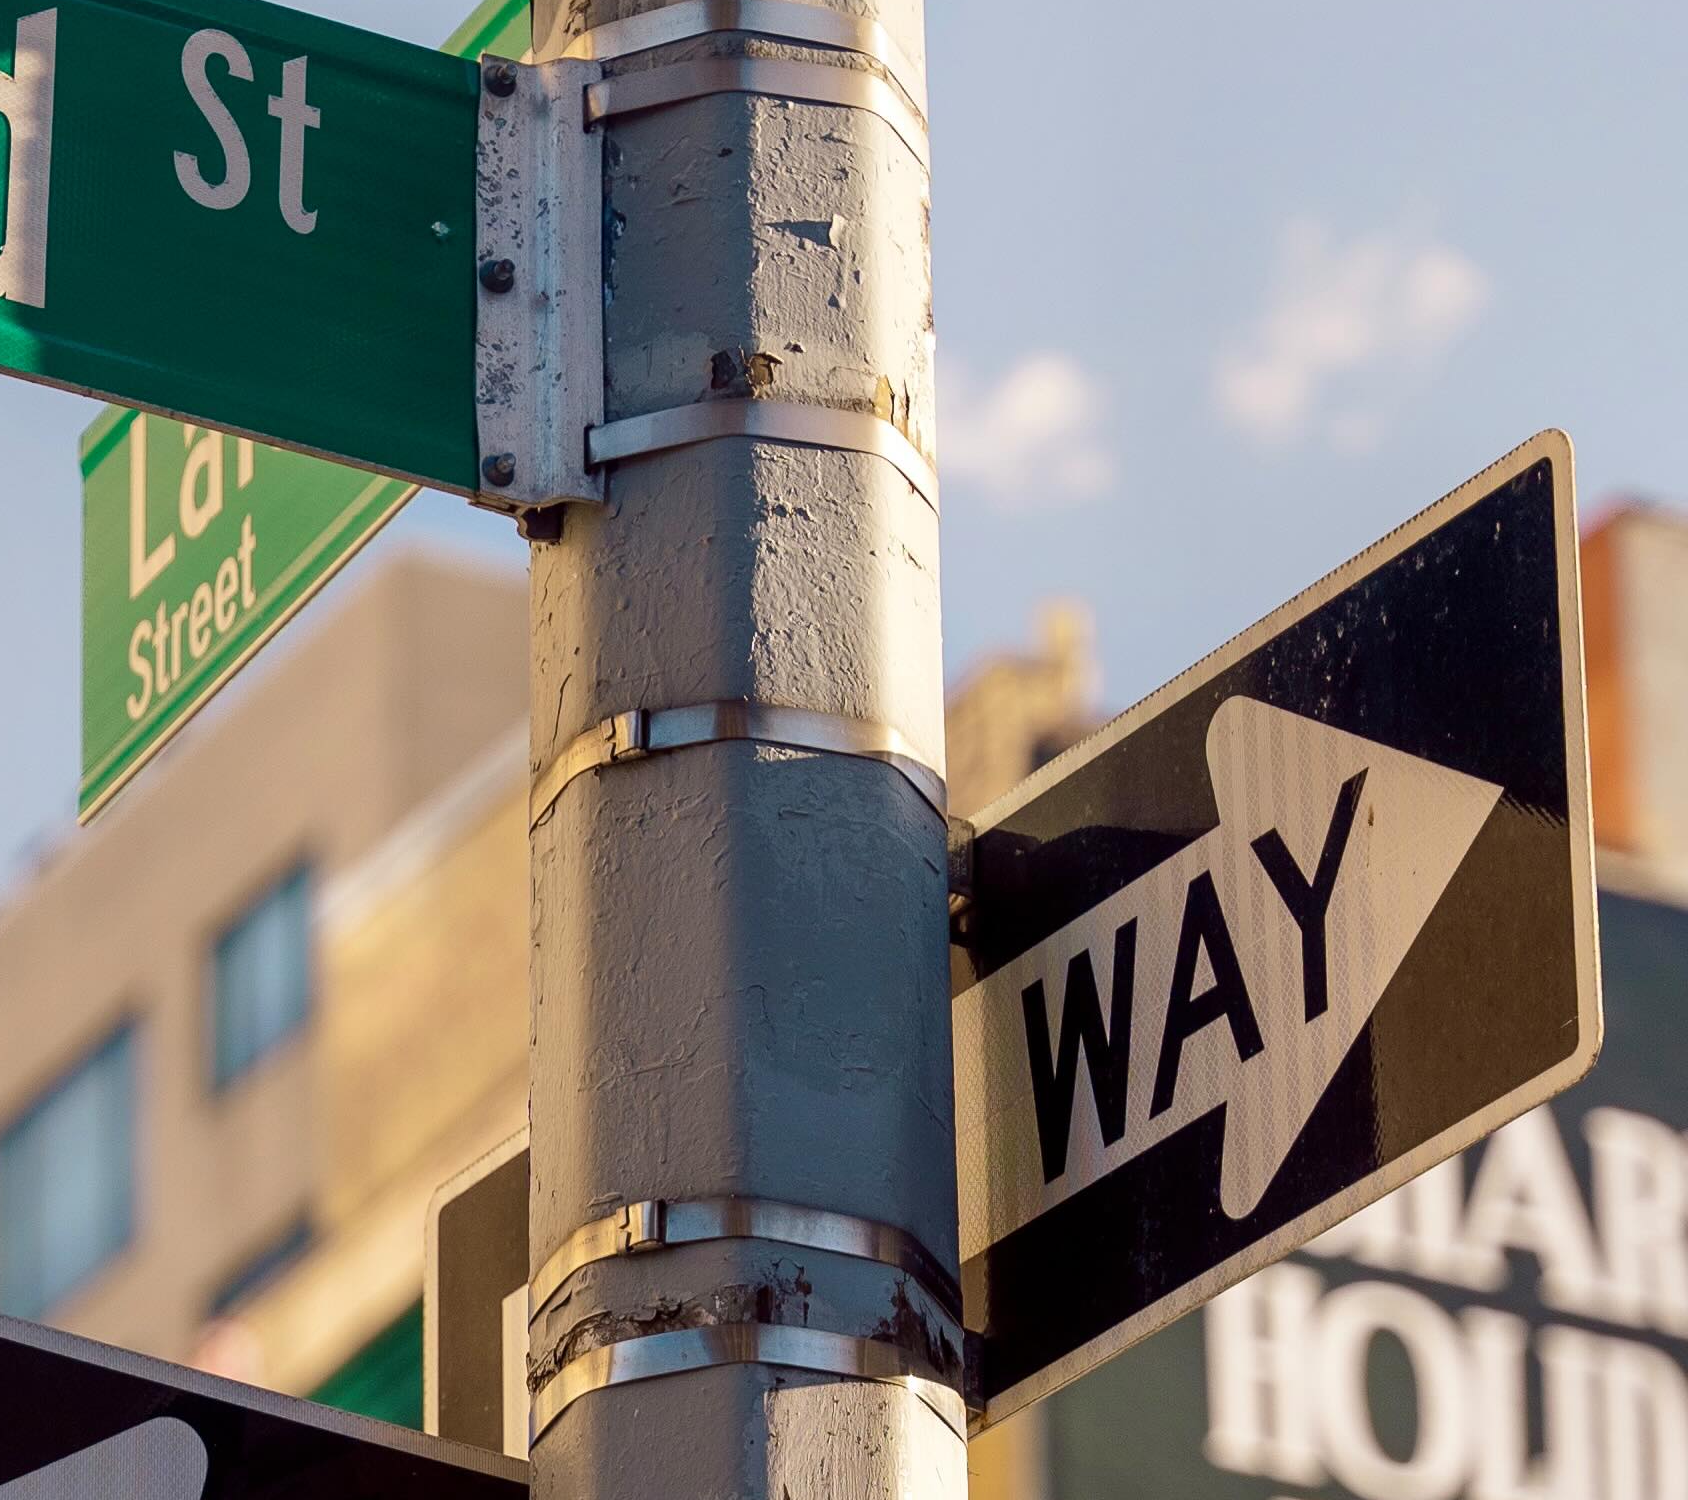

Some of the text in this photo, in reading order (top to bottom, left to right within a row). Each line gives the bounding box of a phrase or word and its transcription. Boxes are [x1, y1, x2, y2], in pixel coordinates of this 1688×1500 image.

[172, 28, 321, 235] St
[126, 513, 257, 720] Street
[1020, 766, 1369, 1186] WAY
